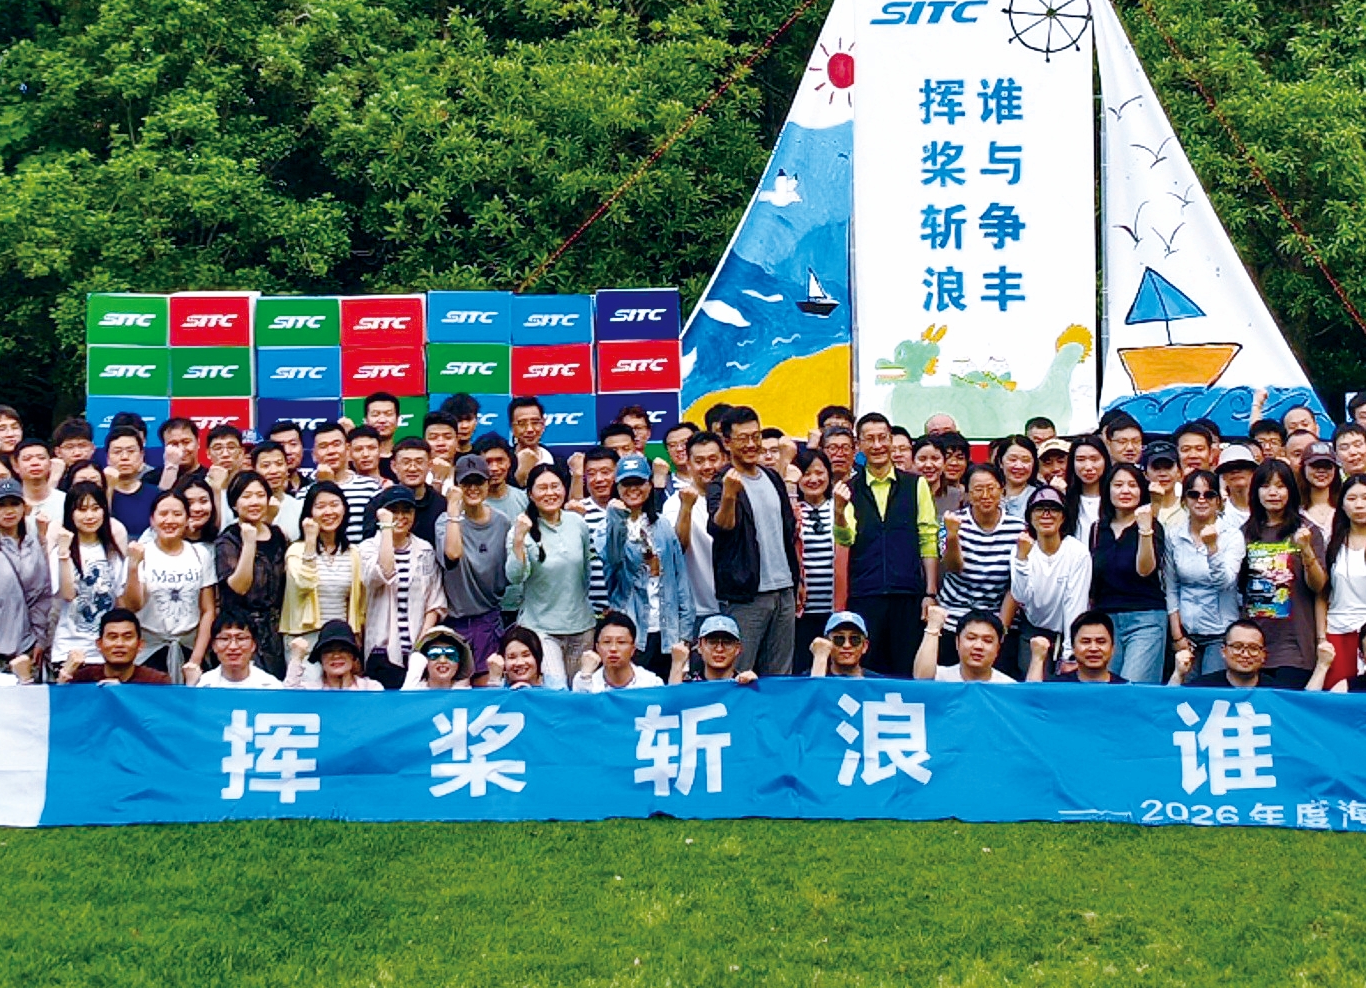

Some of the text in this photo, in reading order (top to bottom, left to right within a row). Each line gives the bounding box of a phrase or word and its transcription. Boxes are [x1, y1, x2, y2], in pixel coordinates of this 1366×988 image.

[869, 0, 989, 25] SITC
[918, 78, 969, 312] 挥桨斩浪
[976, 77, 1027, 312] 谁与争丰
[98, 313, 156, 327] SITC
[181, 313, 238, 328] SITC
[268, 315, 326, 329] SITC
[441, 310, 499, 324] SITC
[523, 313, 580, 327] SITC
[609, 308, 667, 322] SITC
[353, 316, 411, 330] SITC
[99, 364, 156, 378] SITC
[182, 364, 239, 379] SITC
[270, 366, 327, 379] SITC
[353, 364, 410, 379] SITC
[440, 361, 497, 375] SITC
[522, 363, 580, 379] SITC
[611, 358, 669, 373] SITC
[152, 568, 199, 583] Mardi
[221, 693, 932, 803] 挥桨斩浪
